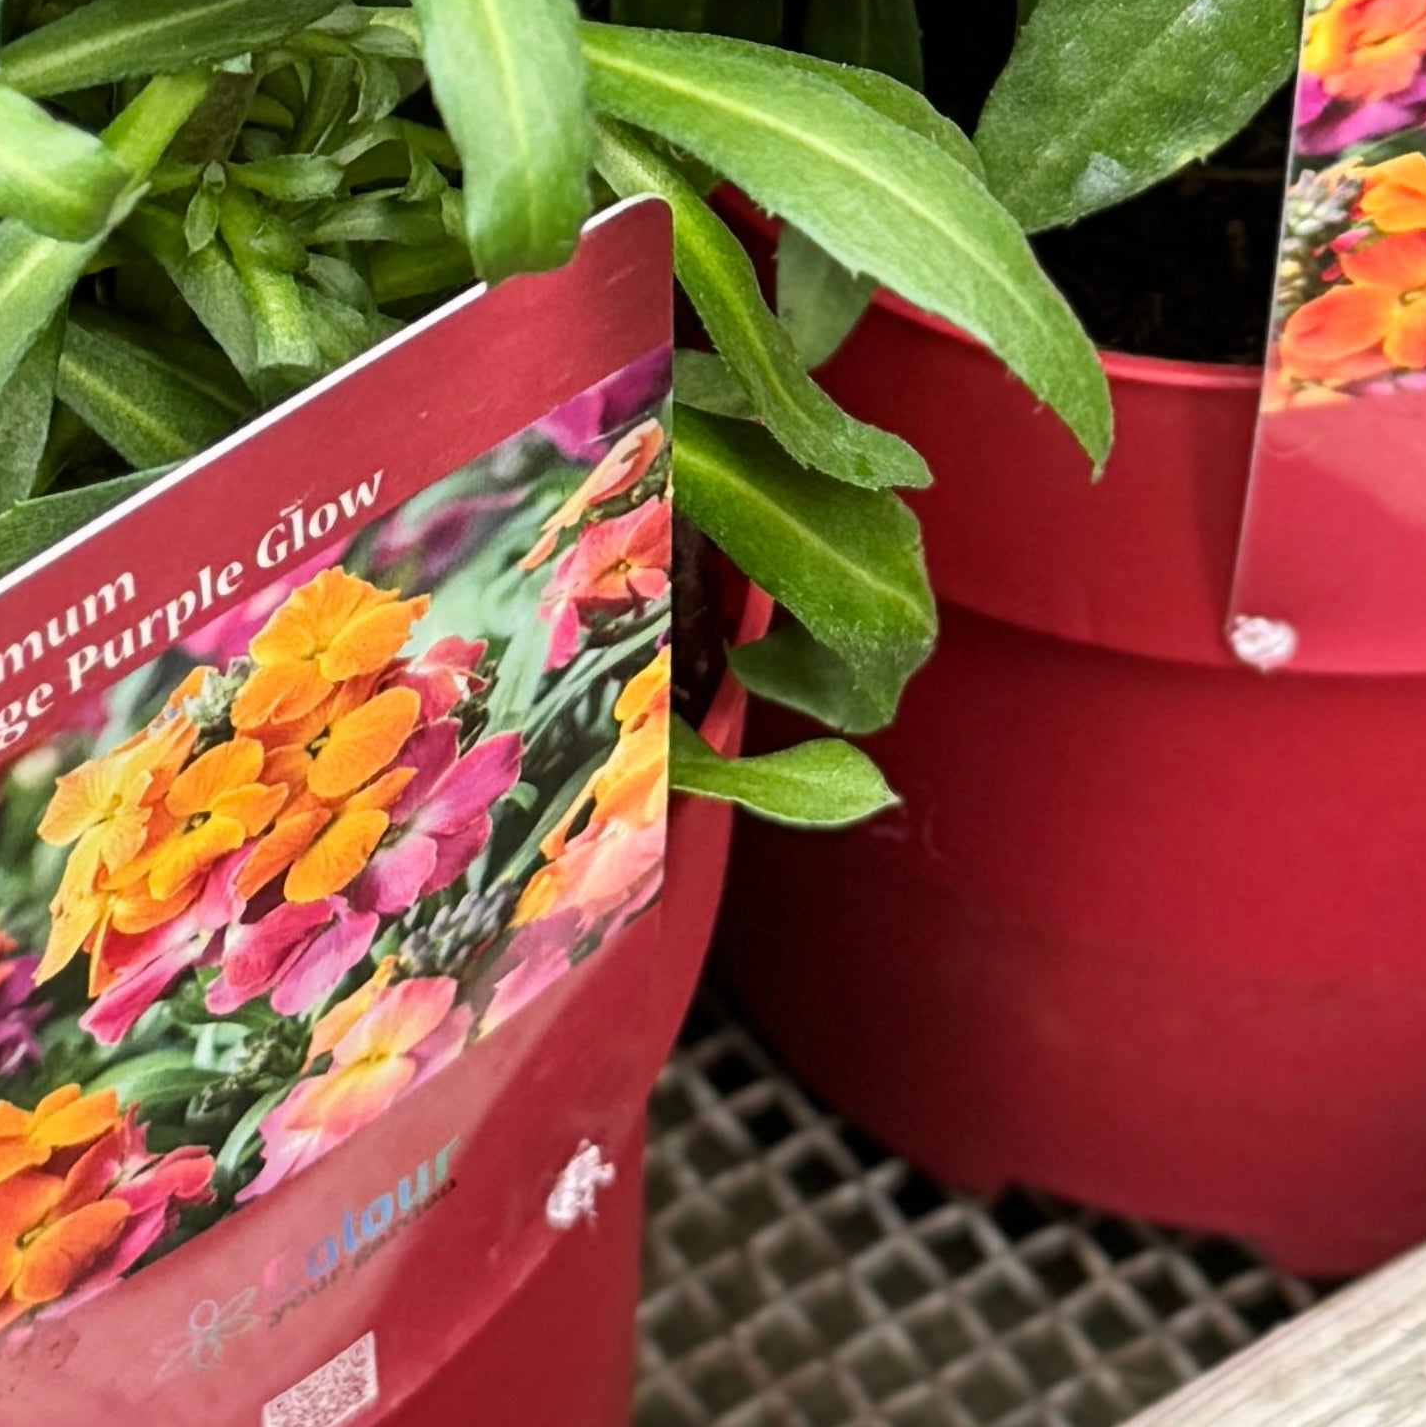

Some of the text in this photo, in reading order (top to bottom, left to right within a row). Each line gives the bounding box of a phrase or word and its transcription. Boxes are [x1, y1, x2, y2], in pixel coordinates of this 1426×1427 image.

[66, 560, 244, 695] Purple
[255, 467, 385, 571] Glow
[262, 1134, 461, 1301] Colour
